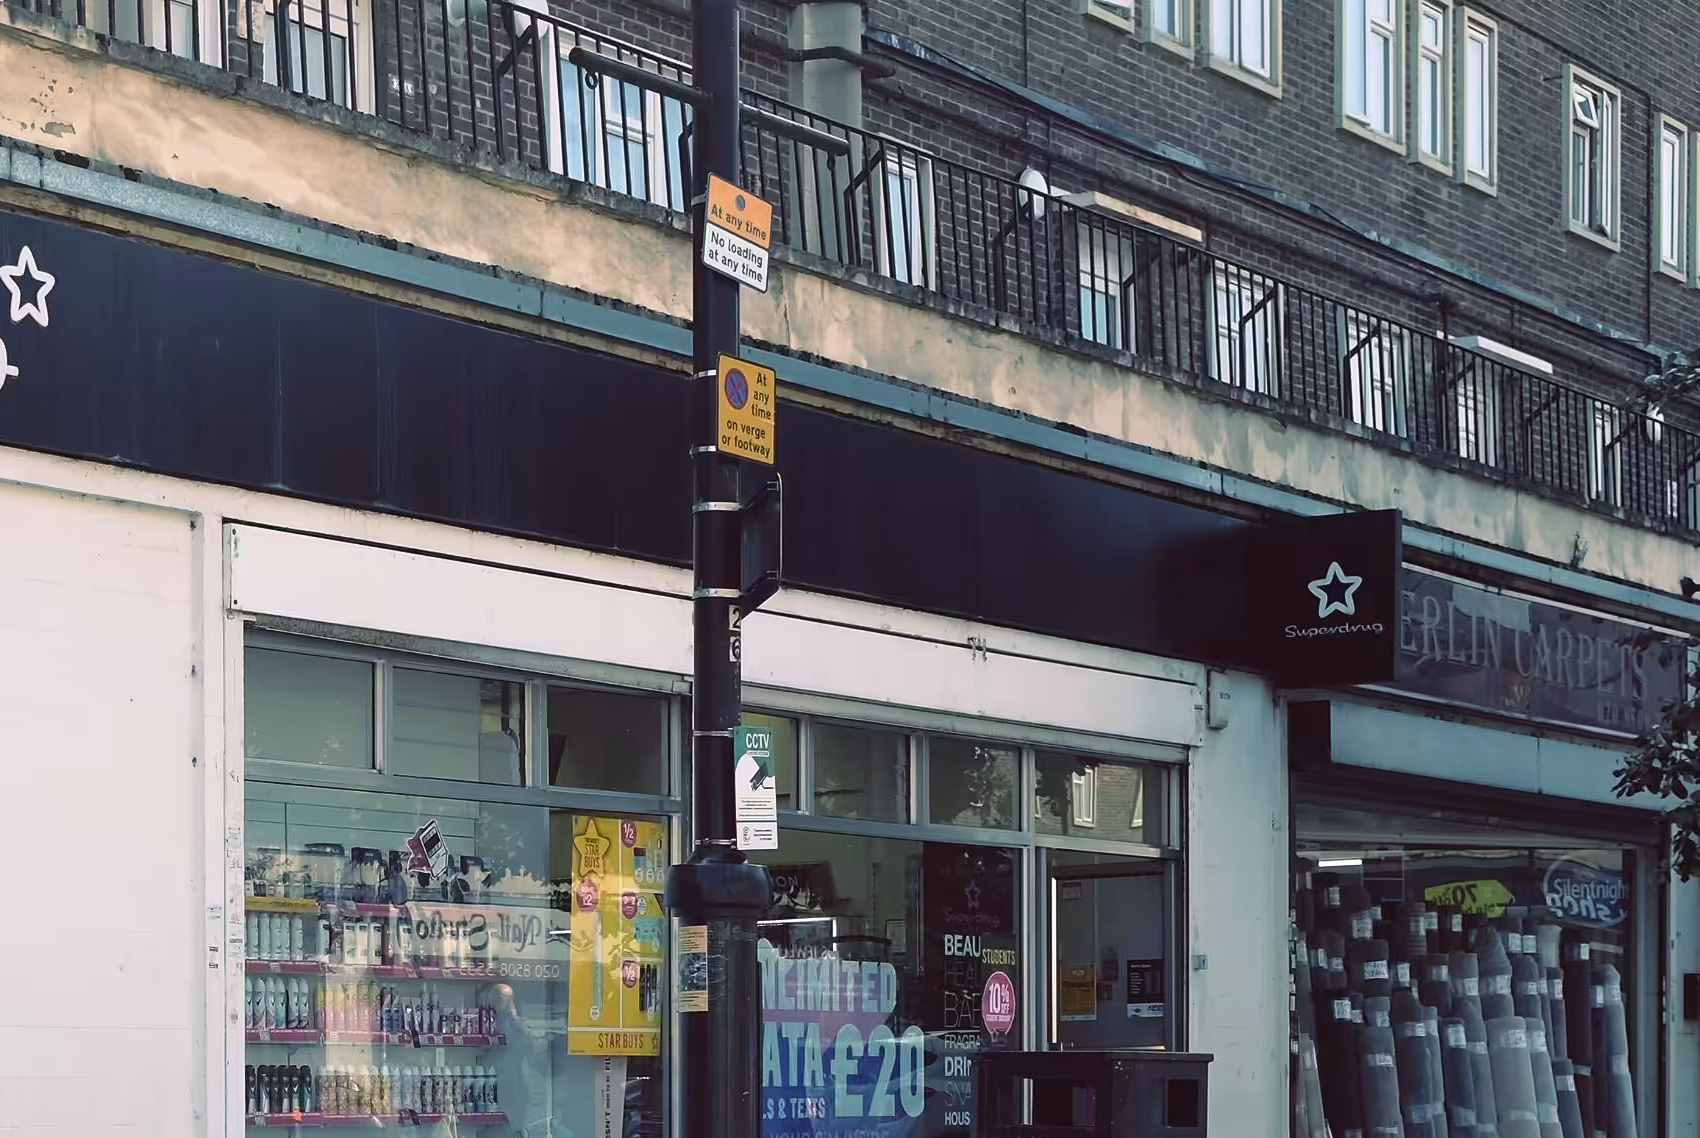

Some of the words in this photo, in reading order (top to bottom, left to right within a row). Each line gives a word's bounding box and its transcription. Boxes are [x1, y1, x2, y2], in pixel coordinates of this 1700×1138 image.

[711, 203, 722, 219] At
[725, 212, 742, 230] any
[745, 221, 766, 240] time
[711, 231, 725, 247] No
[728, 239, 763, 268] loading
[708, 249, 718, 262] at
[721, 255, 738, 272] any
[741, 262, 763, 282] time
[756, 372, 767, 387] At
[753, 390, 769, 405] any
[751, 404, 771, 420] time
[726, 420, 738, 431] on
[740, 423, 765, 439] verge
[722, 435, 731, 445] or
[734, 436, 770, 458] footway
[732, 607, 740, 629] 2
[1285, 622, 1383, 638] Superdrug
[1400, 589, 1501, 673] ERLIN
[1515, 623, 1650, 701] CARPETS
[745, 733, 770, 750] CCTV
[584, 844, 600, 856] STAR
[584, 856, 600, 868] BUYS
[944, 934, 981, 957] BEAU
[982, 948, 1016, 965] STUDENTS
[762, 954, 897, 1013] NLIMITED
[598, 1033, 620, 1049] STAR
[623, 1033, 644, 1049] BUYS
[944, 1034, 981, 1049] FRAGRA
[763, 1022, 825, 1086] ATA
[830, 1023, 925, 1118] £20
[778, 1099, 787, 1118] &
[790, 1097, 826, 1119] TEXTS
[944, 1111, 971, 1126] HOUS
